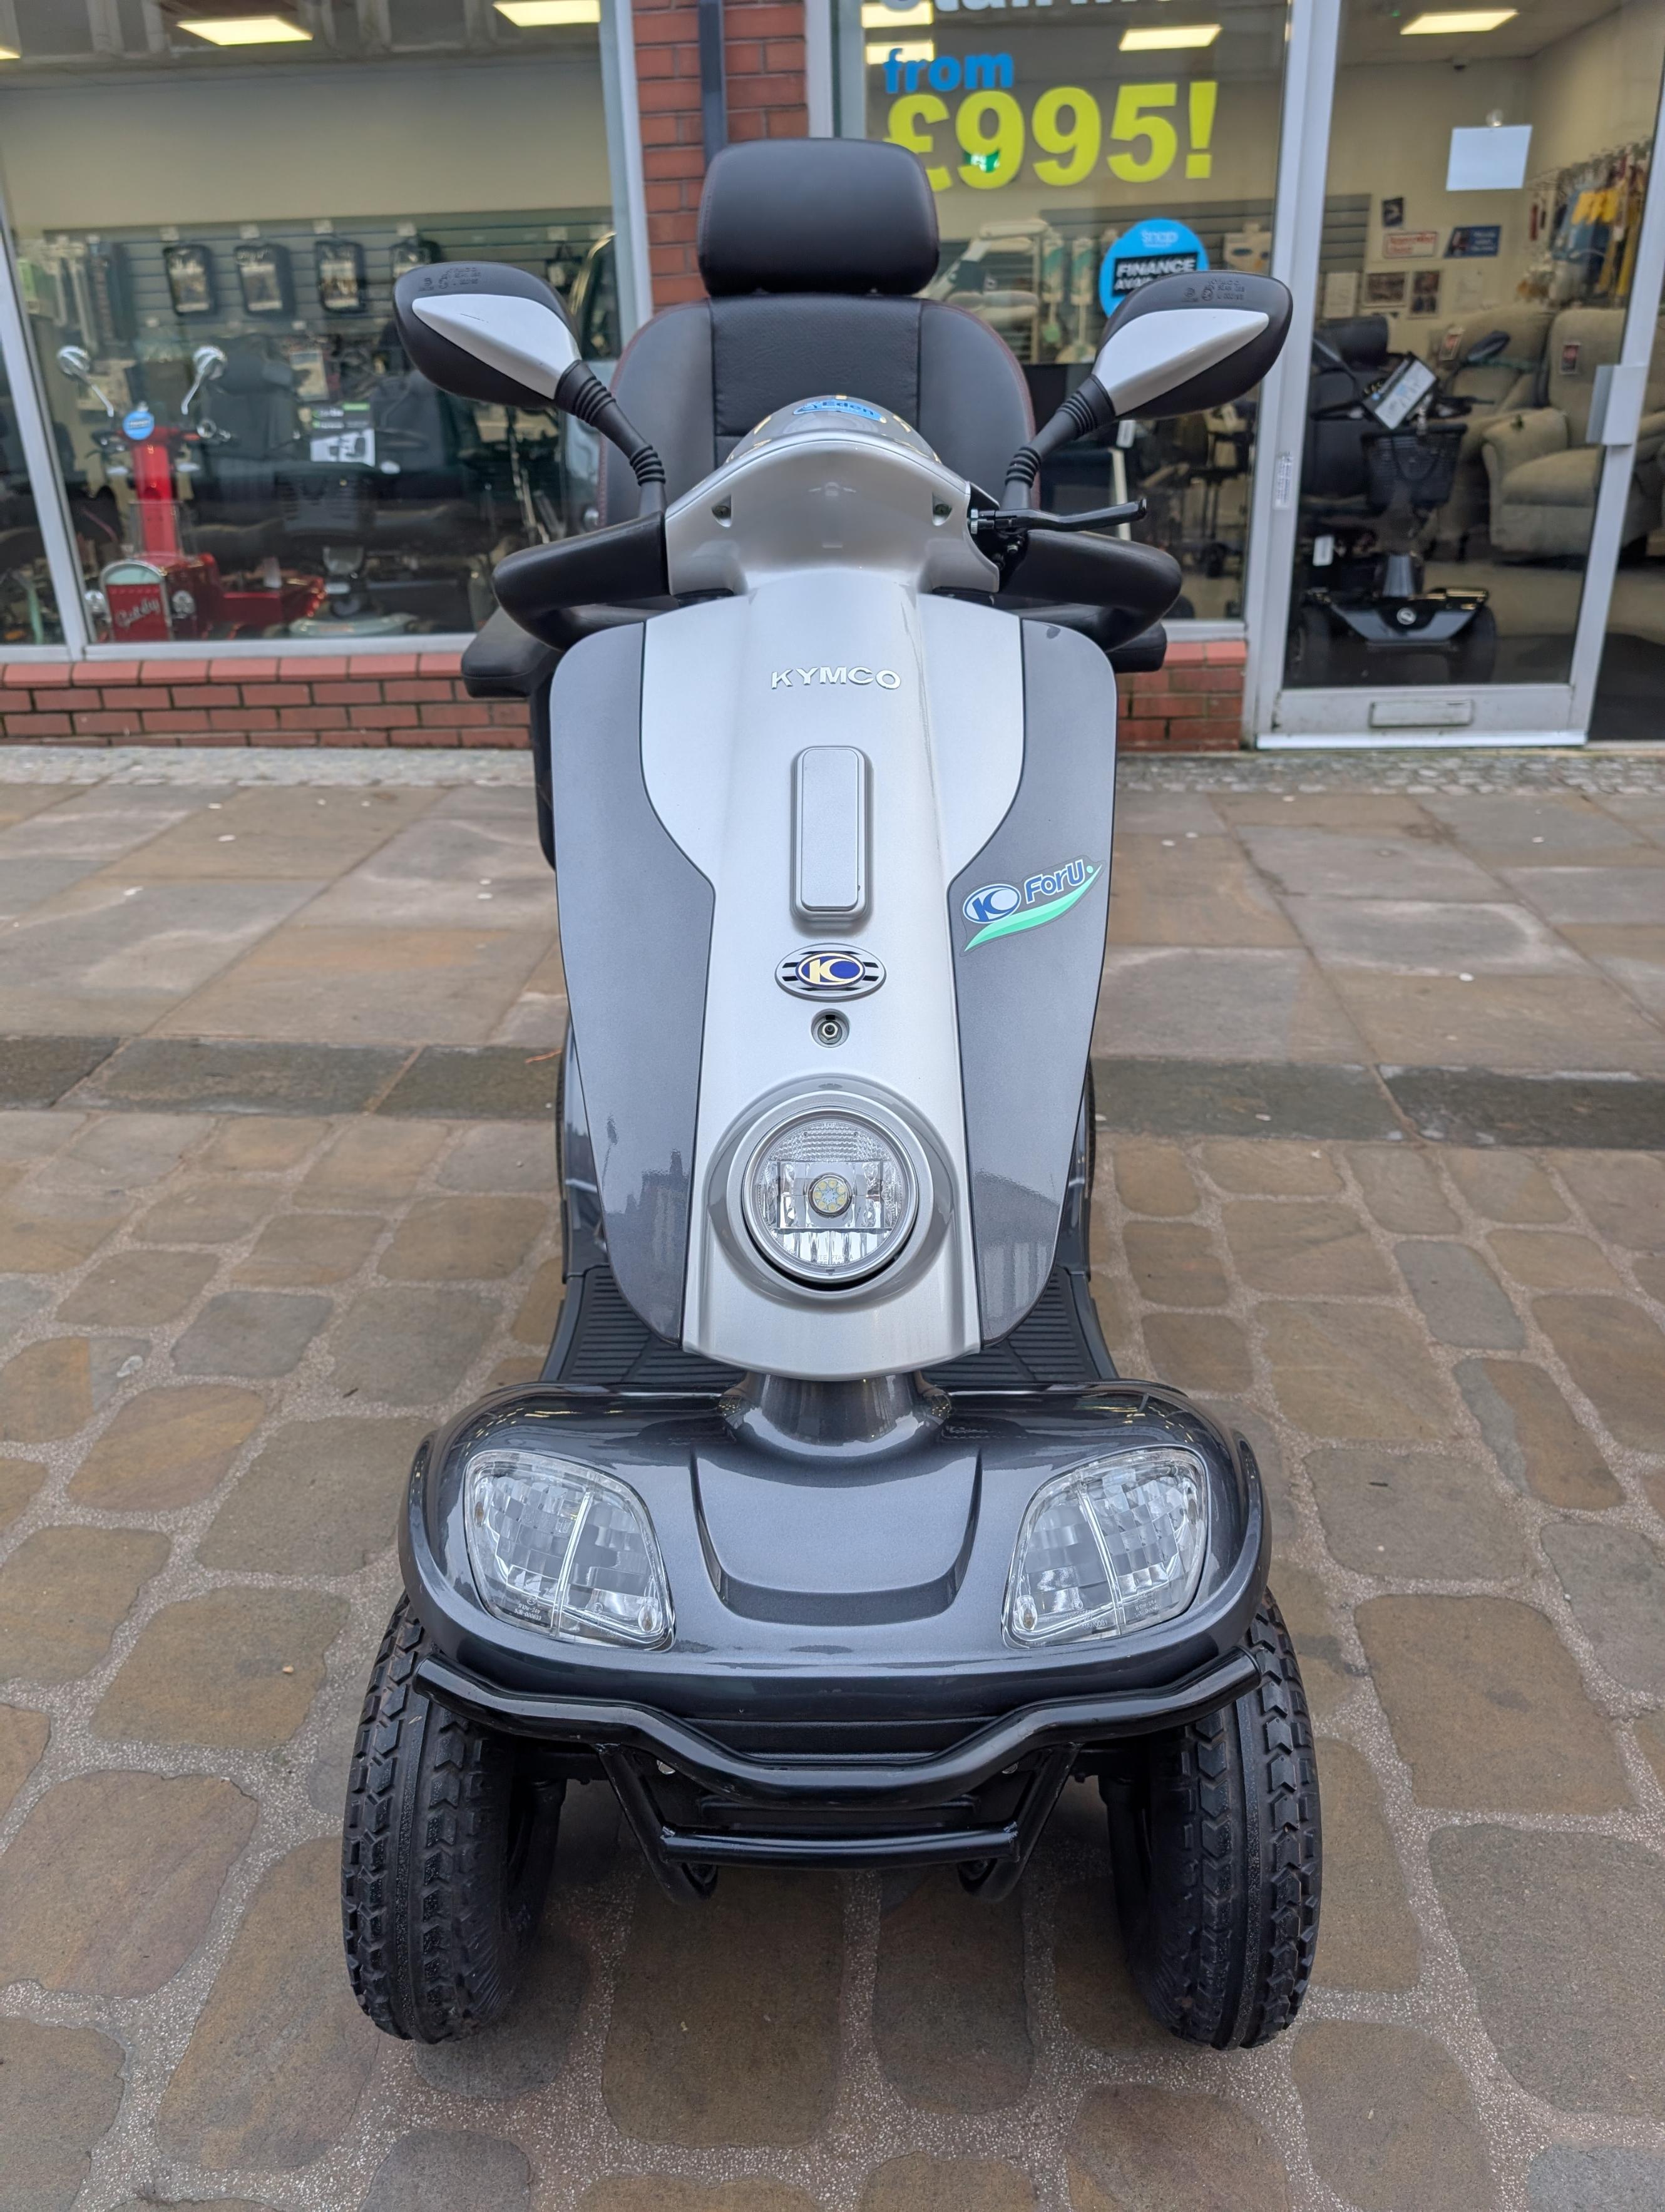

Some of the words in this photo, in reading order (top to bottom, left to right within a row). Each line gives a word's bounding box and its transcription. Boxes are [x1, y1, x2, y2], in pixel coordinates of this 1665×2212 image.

[883, 48, 1013, 93] from
[883, 81, 1217, 191] £995!
[1116, 257, 1197, 278] FINANCE
[771, 666, 901, 689] KYMCO
[1024, 859, 1086, 904] ForU
